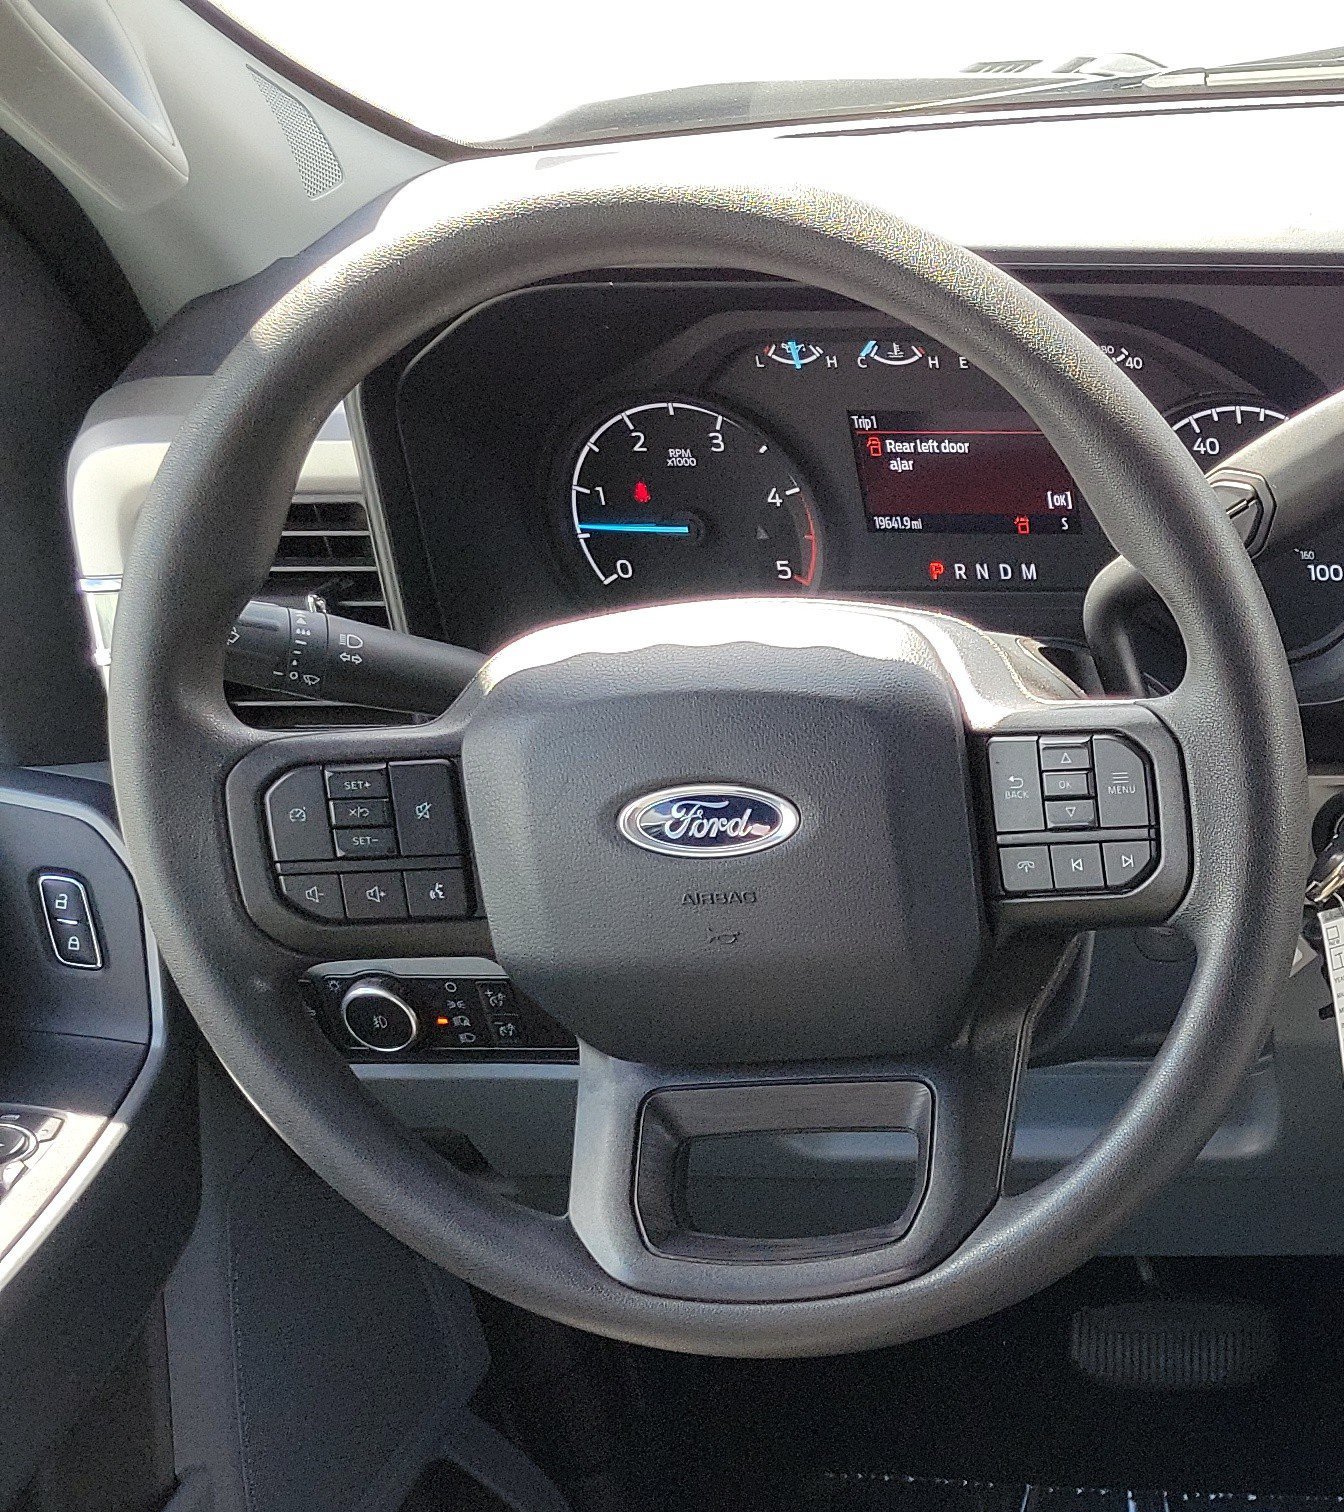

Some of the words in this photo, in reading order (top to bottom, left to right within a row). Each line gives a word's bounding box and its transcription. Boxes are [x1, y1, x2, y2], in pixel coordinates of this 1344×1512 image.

[756, 356, 766, 368] L
[826, 357, 838, 368] H
[857, 357, 868, 368] C
[929, 357, 940, 369] H
[960, 357, 969, 369] E
[1125, 356, 1143, 370] 40
[851, 415, 871, 430] Trip
[631, 432, 648, 452] 2
[709, 432, 725, 452] 3
[885, 440, 914, 454] Rear
[917, 439, 939, 454] left
[941, 440, 970, 454] door
[1193, 437, 1220, 456] 40
[669, 449, 693, 458] RPM
[667, 457, 697, 467] x1000
[889, 458, 914, 472] ajar
[594, 486, 606, 506] 1
[767, 487, 784, 508] 4
[1062, 518, 1069, 530] S
[616, 559, 634, 579] 0
[776, 560, 792, 580] 5
[929, 561, 944, 580] P
[955, 563, 967, 580] R
[976, 563, 990, 580] N
[1000, 564, 1012, 580] D
[1022, 564, 1038, 580] M
[1307, 565, 1344, 582] 100
[344, 780, 372, 790] SET+
[1058, 780, 1072, 790] OK
[1108, 786, 1136, 795] MENU
[1005, 791, 1030, 800] BACK
[664, 800, 753, 840] Ford
[681, 891, 757, 906] AIRBAG
